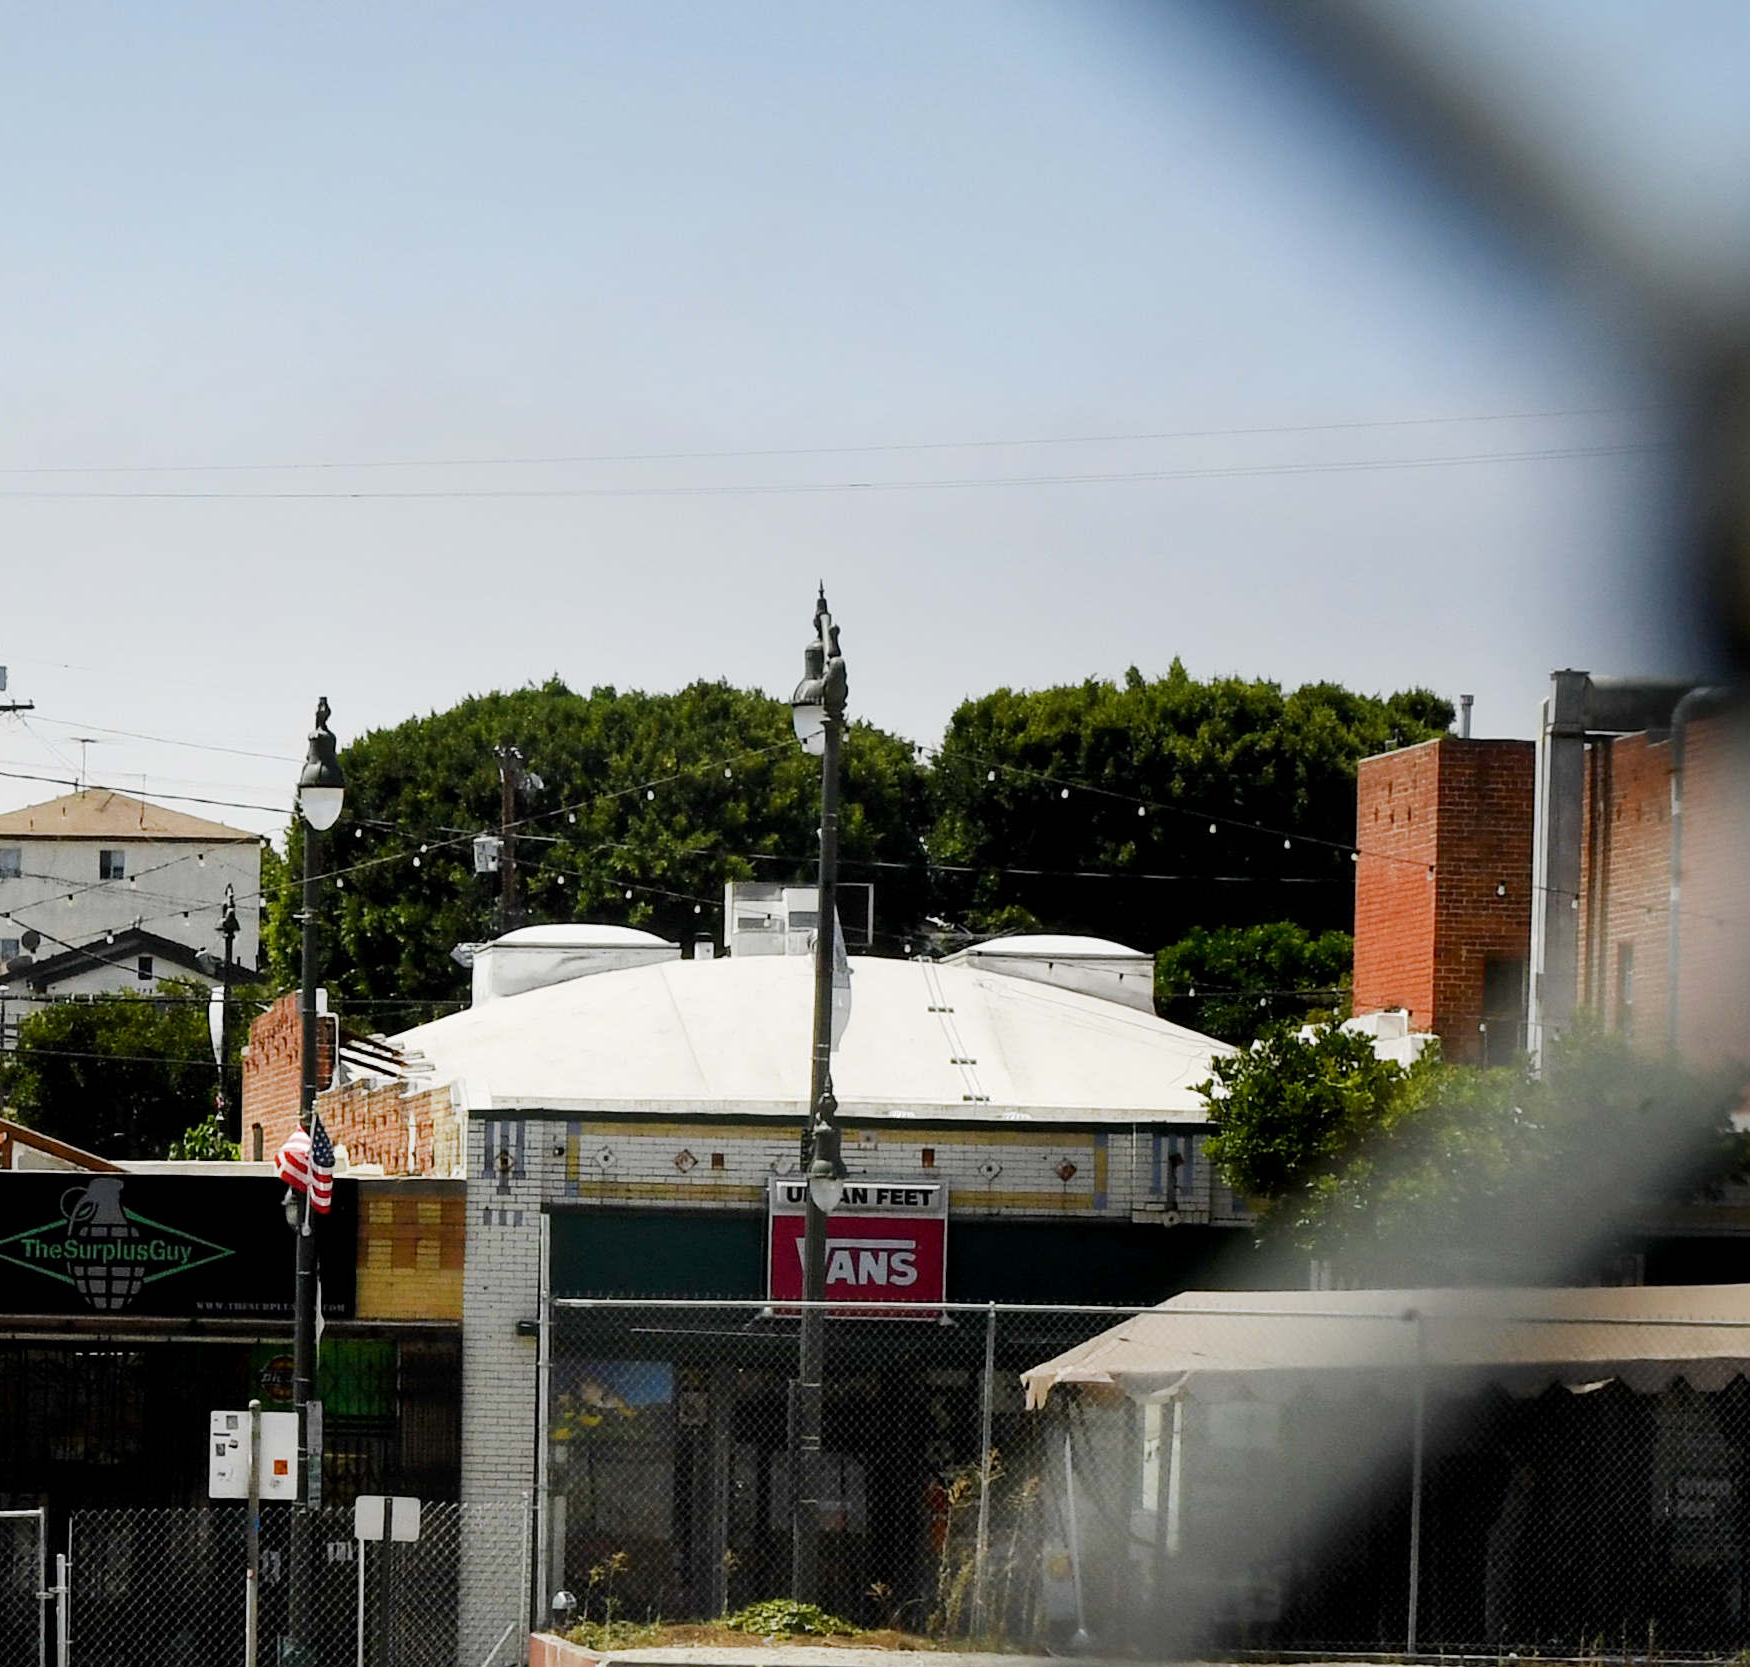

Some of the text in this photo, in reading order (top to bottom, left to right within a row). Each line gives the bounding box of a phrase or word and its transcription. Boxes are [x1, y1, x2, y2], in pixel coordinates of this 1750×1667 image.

[786, 1187, 933, 1207] UAN FEET
[21, 1237, 193, 1265] TheSurplusGuy
